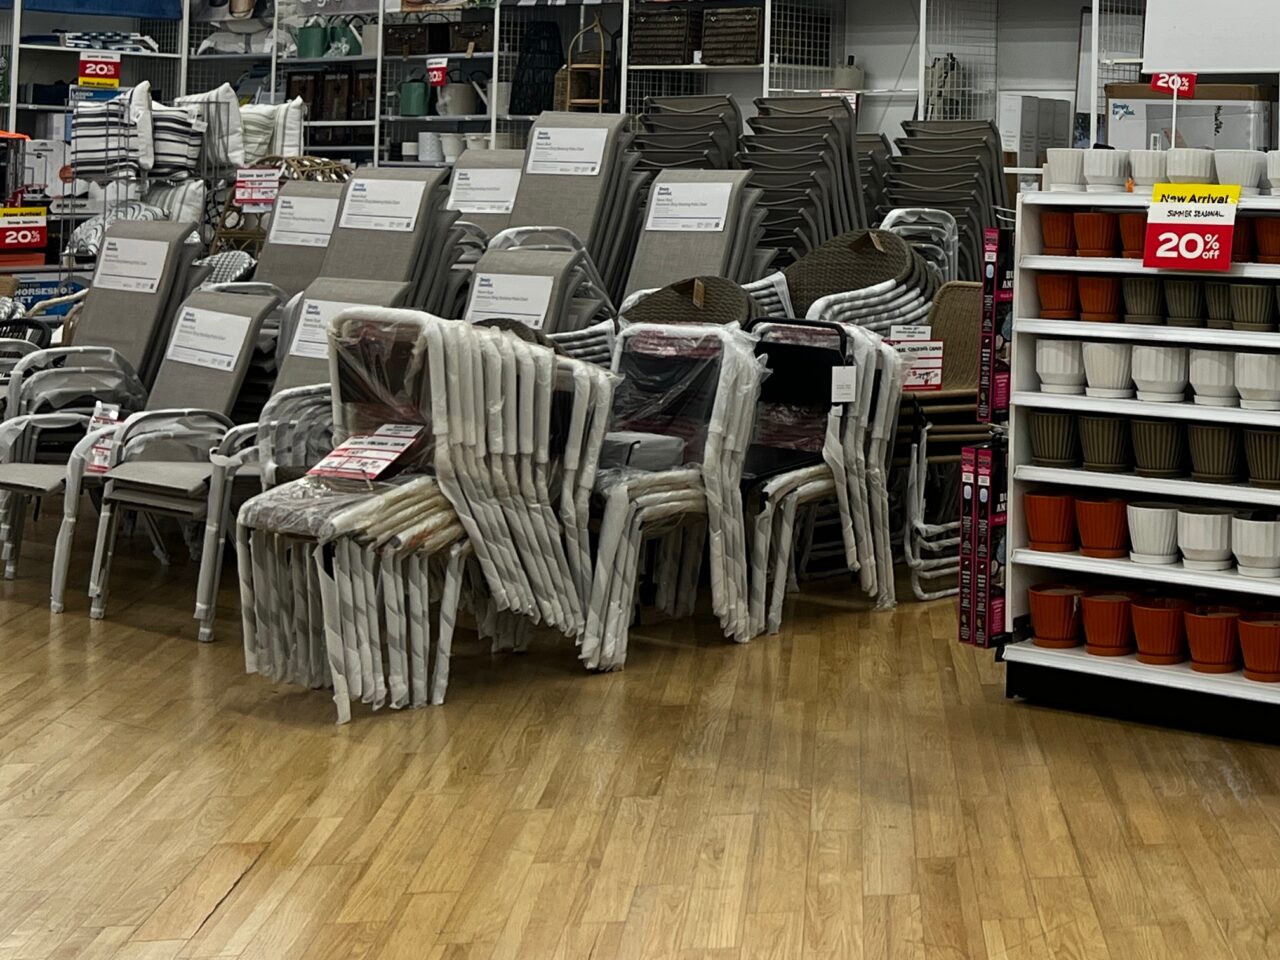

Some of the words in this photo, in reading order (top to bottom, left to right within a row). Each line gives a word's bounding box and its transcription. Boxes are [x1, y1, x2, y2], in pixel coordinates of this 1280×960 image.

[1157, 73, 1189, 89] 20%
[1160, 194, 1187, 203] New
[1188, 194, 1229, 203] Arrival
[5, 231, 40, 243] 20%
[1156, 232, 1219, 259] 20%
[1202, 250, 1219, 259] off
